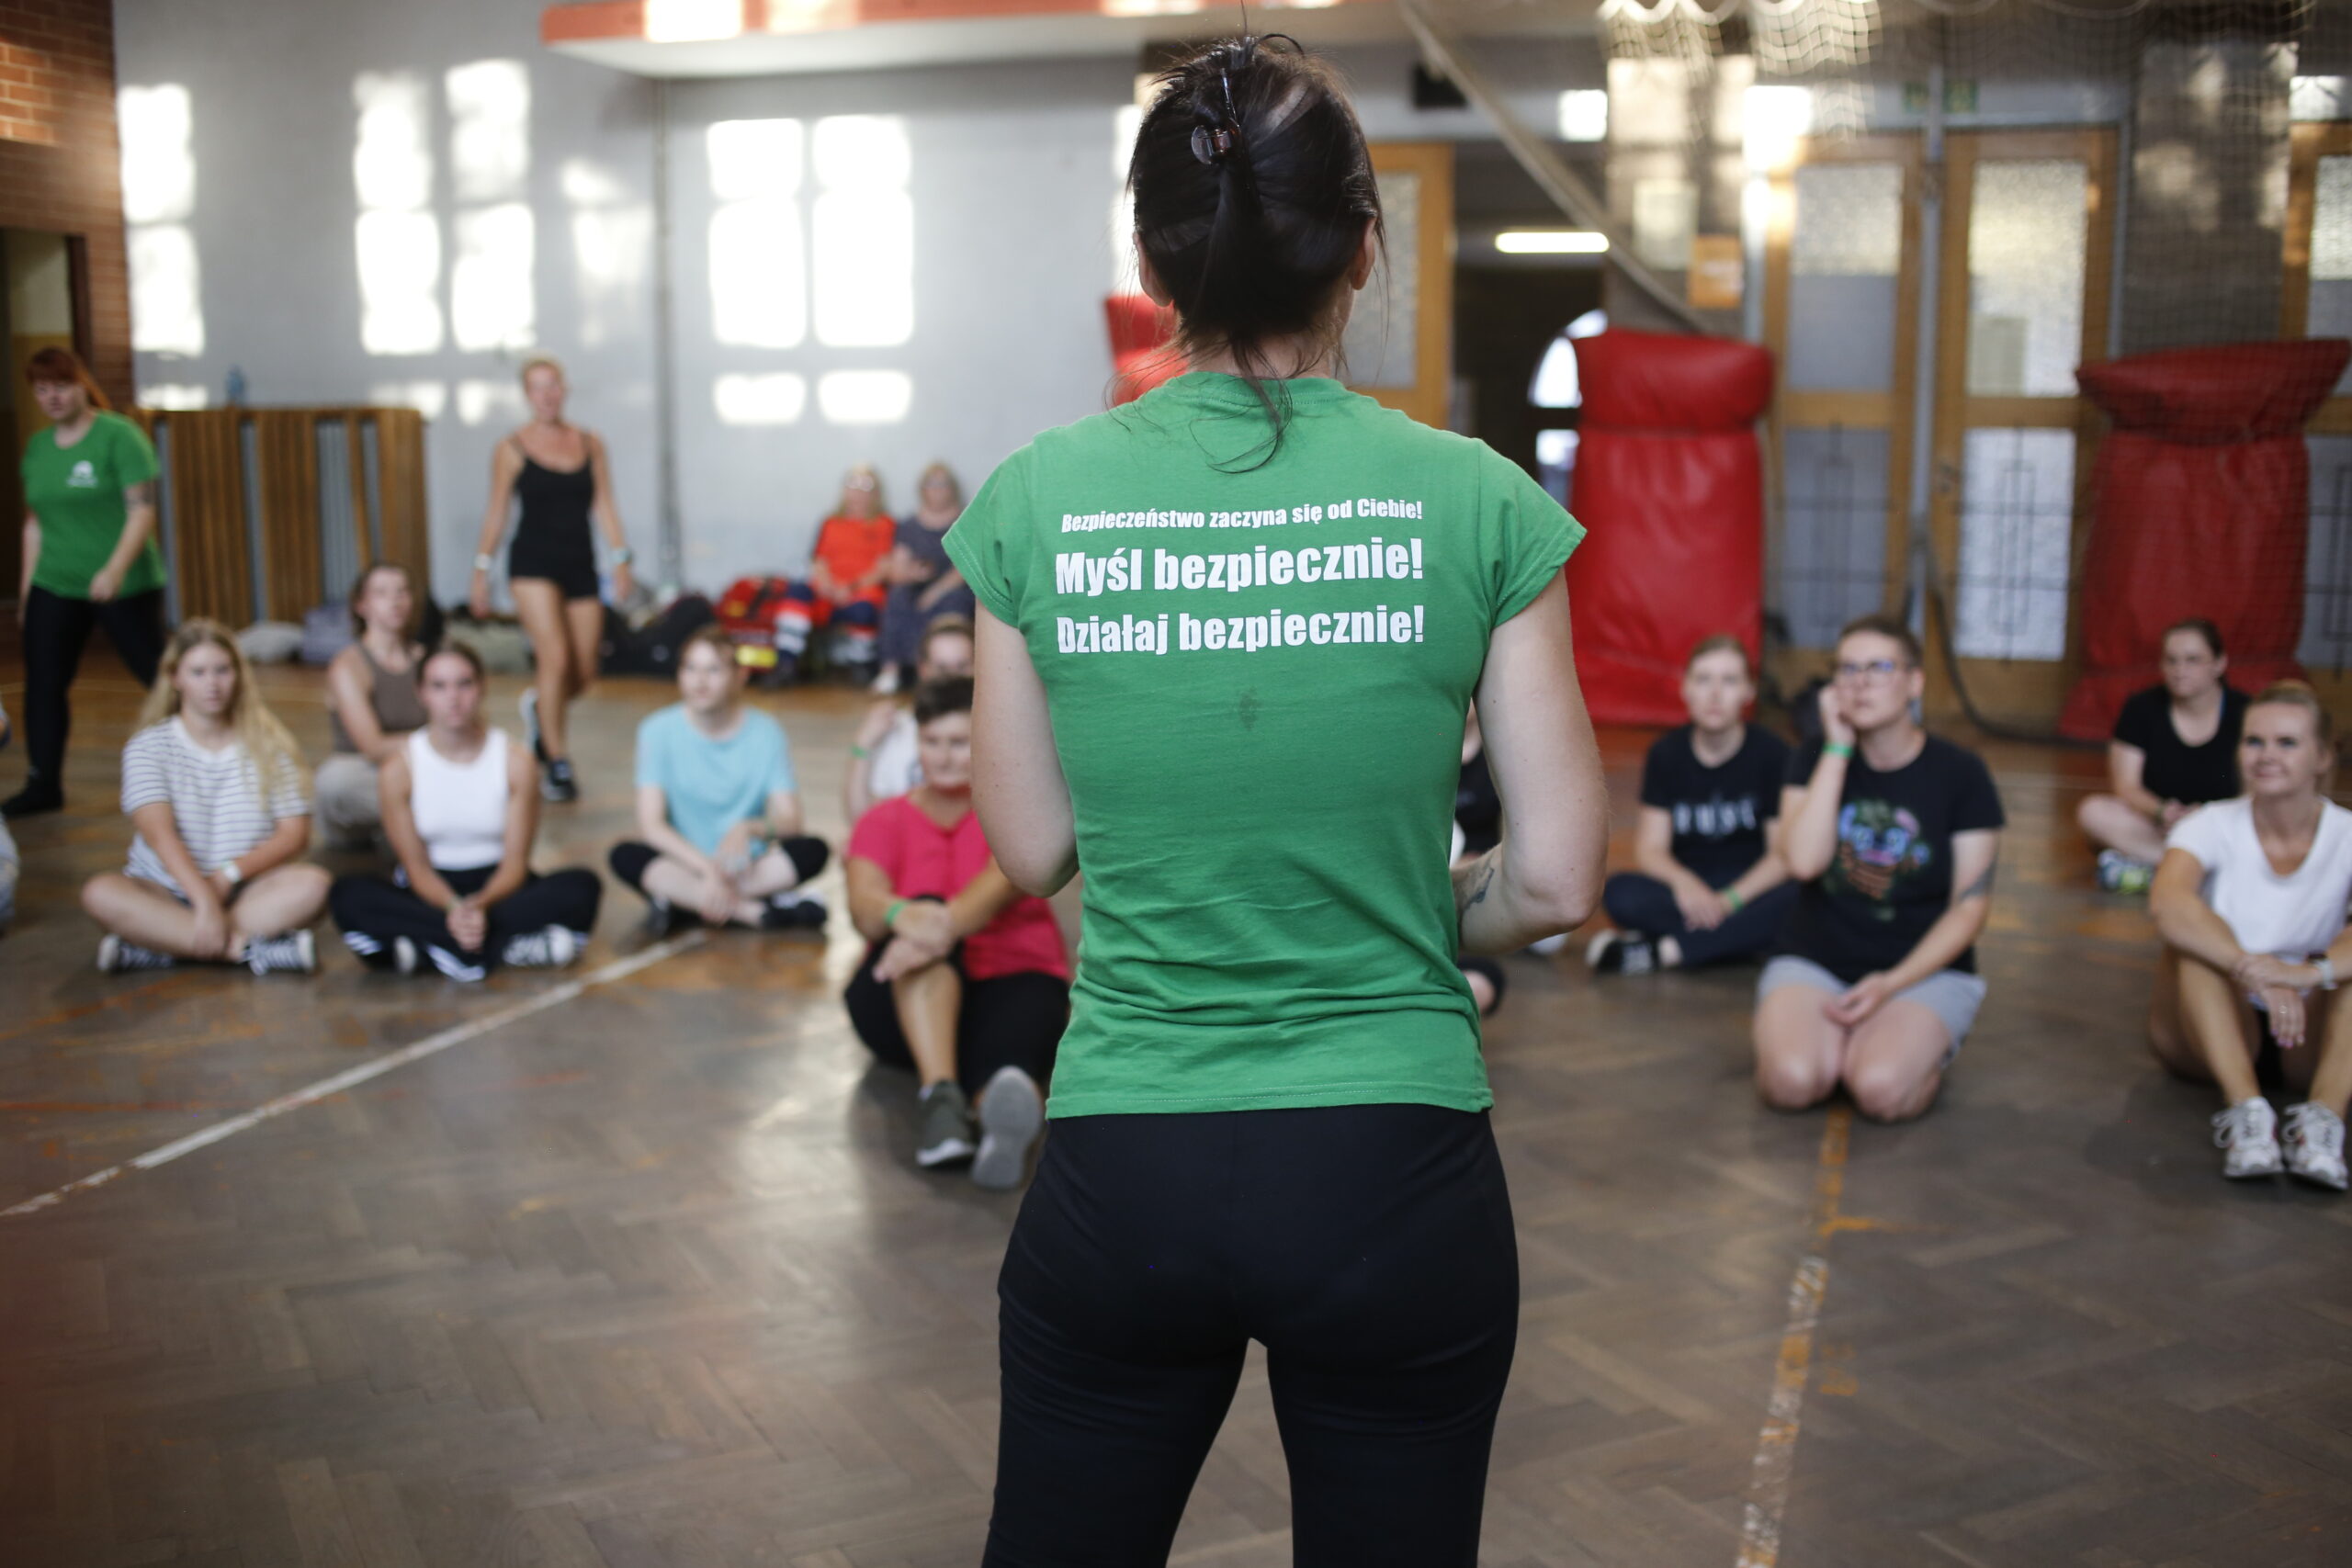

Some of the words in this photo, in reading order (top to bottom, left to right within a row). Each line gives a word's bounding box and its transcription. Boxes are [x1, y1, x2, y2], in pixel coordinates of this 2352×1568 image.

[1060, 507, 1205, 534] Bezpieczeństwo
[1208, 508, 1288, 529] zaczyna
[1292, 502, 1323, 525] się
[1327, 499, 1353, 520] od
[1356, 498, 1423, 520] Ciebie!
[1055, 547, 1143, 597] Myśl
[1154, 536, 1423, 592] bezpiecznie!
[1056, 613, 1169, 655] Działaj
[1179, 604, 1424, 652] bezpiecznie!
